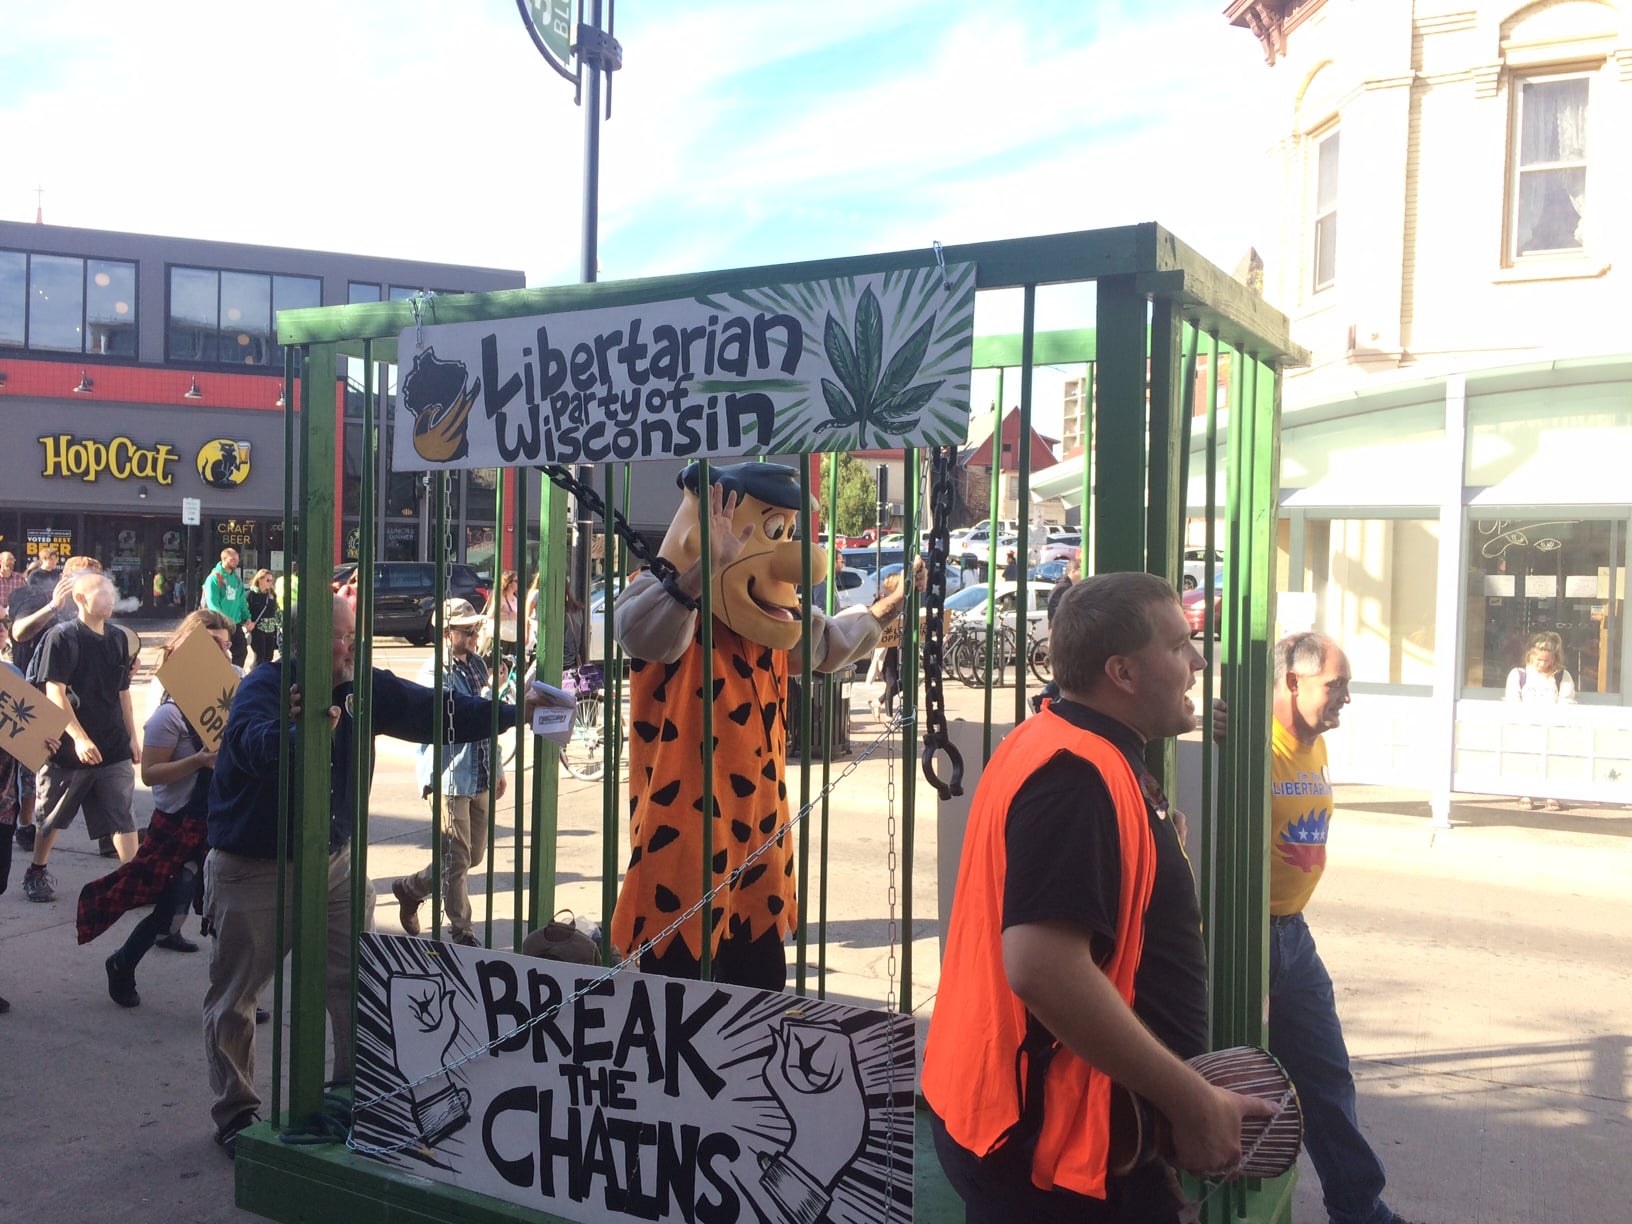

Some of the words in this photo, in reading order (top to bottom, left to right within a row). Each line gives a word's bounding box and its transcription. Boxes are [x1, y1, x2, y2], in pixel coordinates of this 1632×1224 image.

[481, 313, 803, 419] Libertarian
[645, 373, 694, 413] of
[495, 393, 775, 462] Wisconsin
[39, 435, 178, 485] HopCat
[217, 523, 255, 534] CRAFT
[222, 535, 251, 544] BEER
[475, 960, 733, 1100] BREAK
[559, 1064, 637, 1110] THE
[482, 1086, 741, 1224] CHAINS
